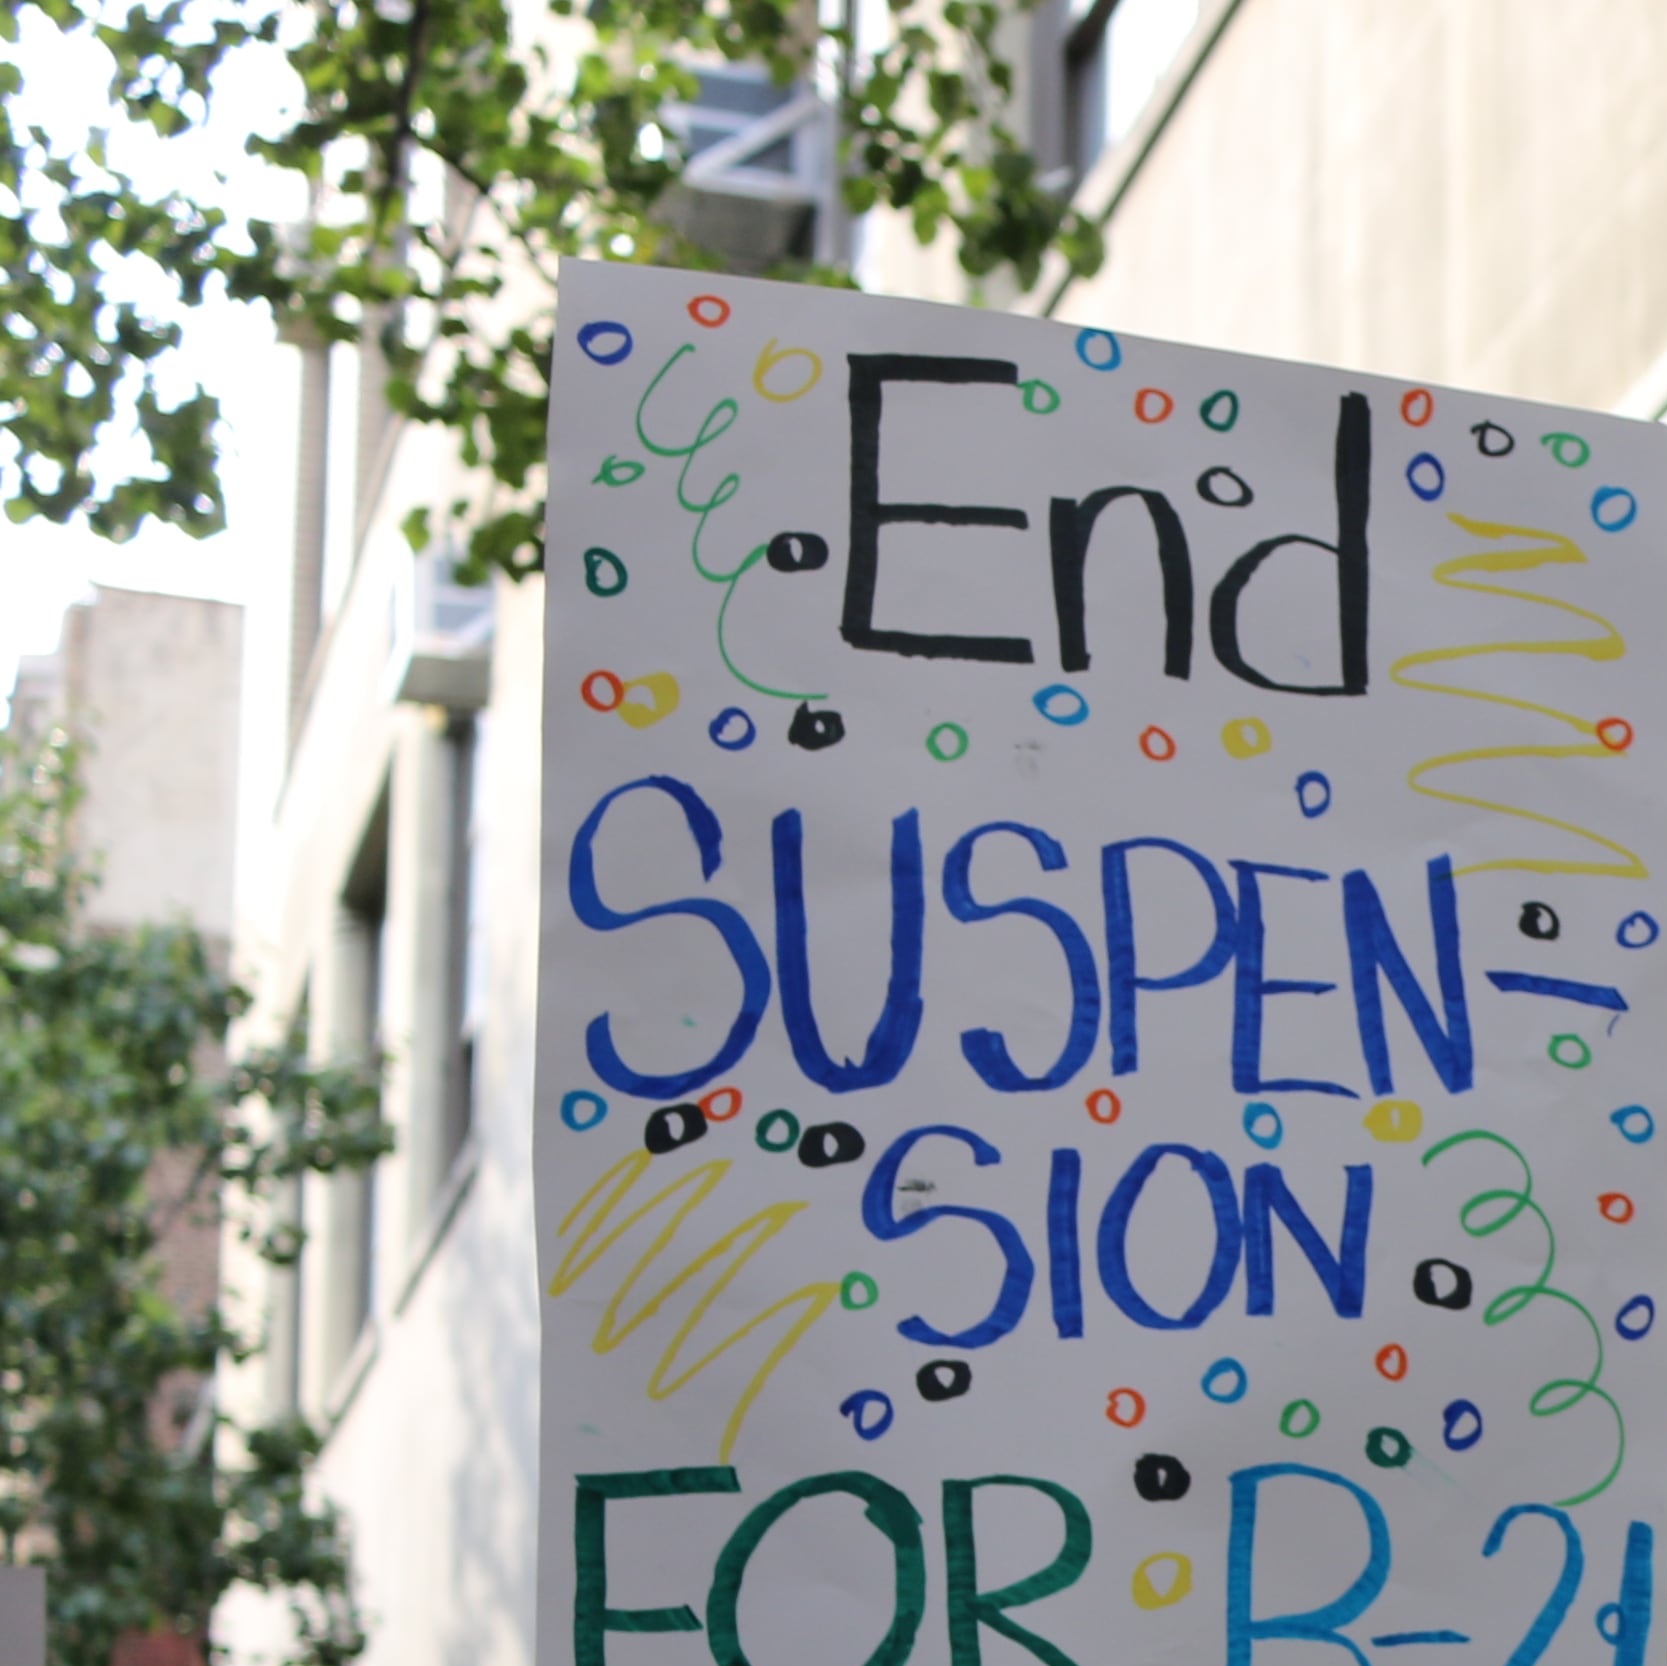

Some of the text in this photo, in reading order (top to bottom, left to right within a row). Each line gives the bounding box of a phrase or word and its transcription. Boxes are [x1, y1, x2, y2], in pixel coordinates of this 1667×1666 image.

[840, 354, 1369, 697] End
[569, 774, 1630, 1100] SUSPEN-
[862, 1123, 1373, 1349] SION
